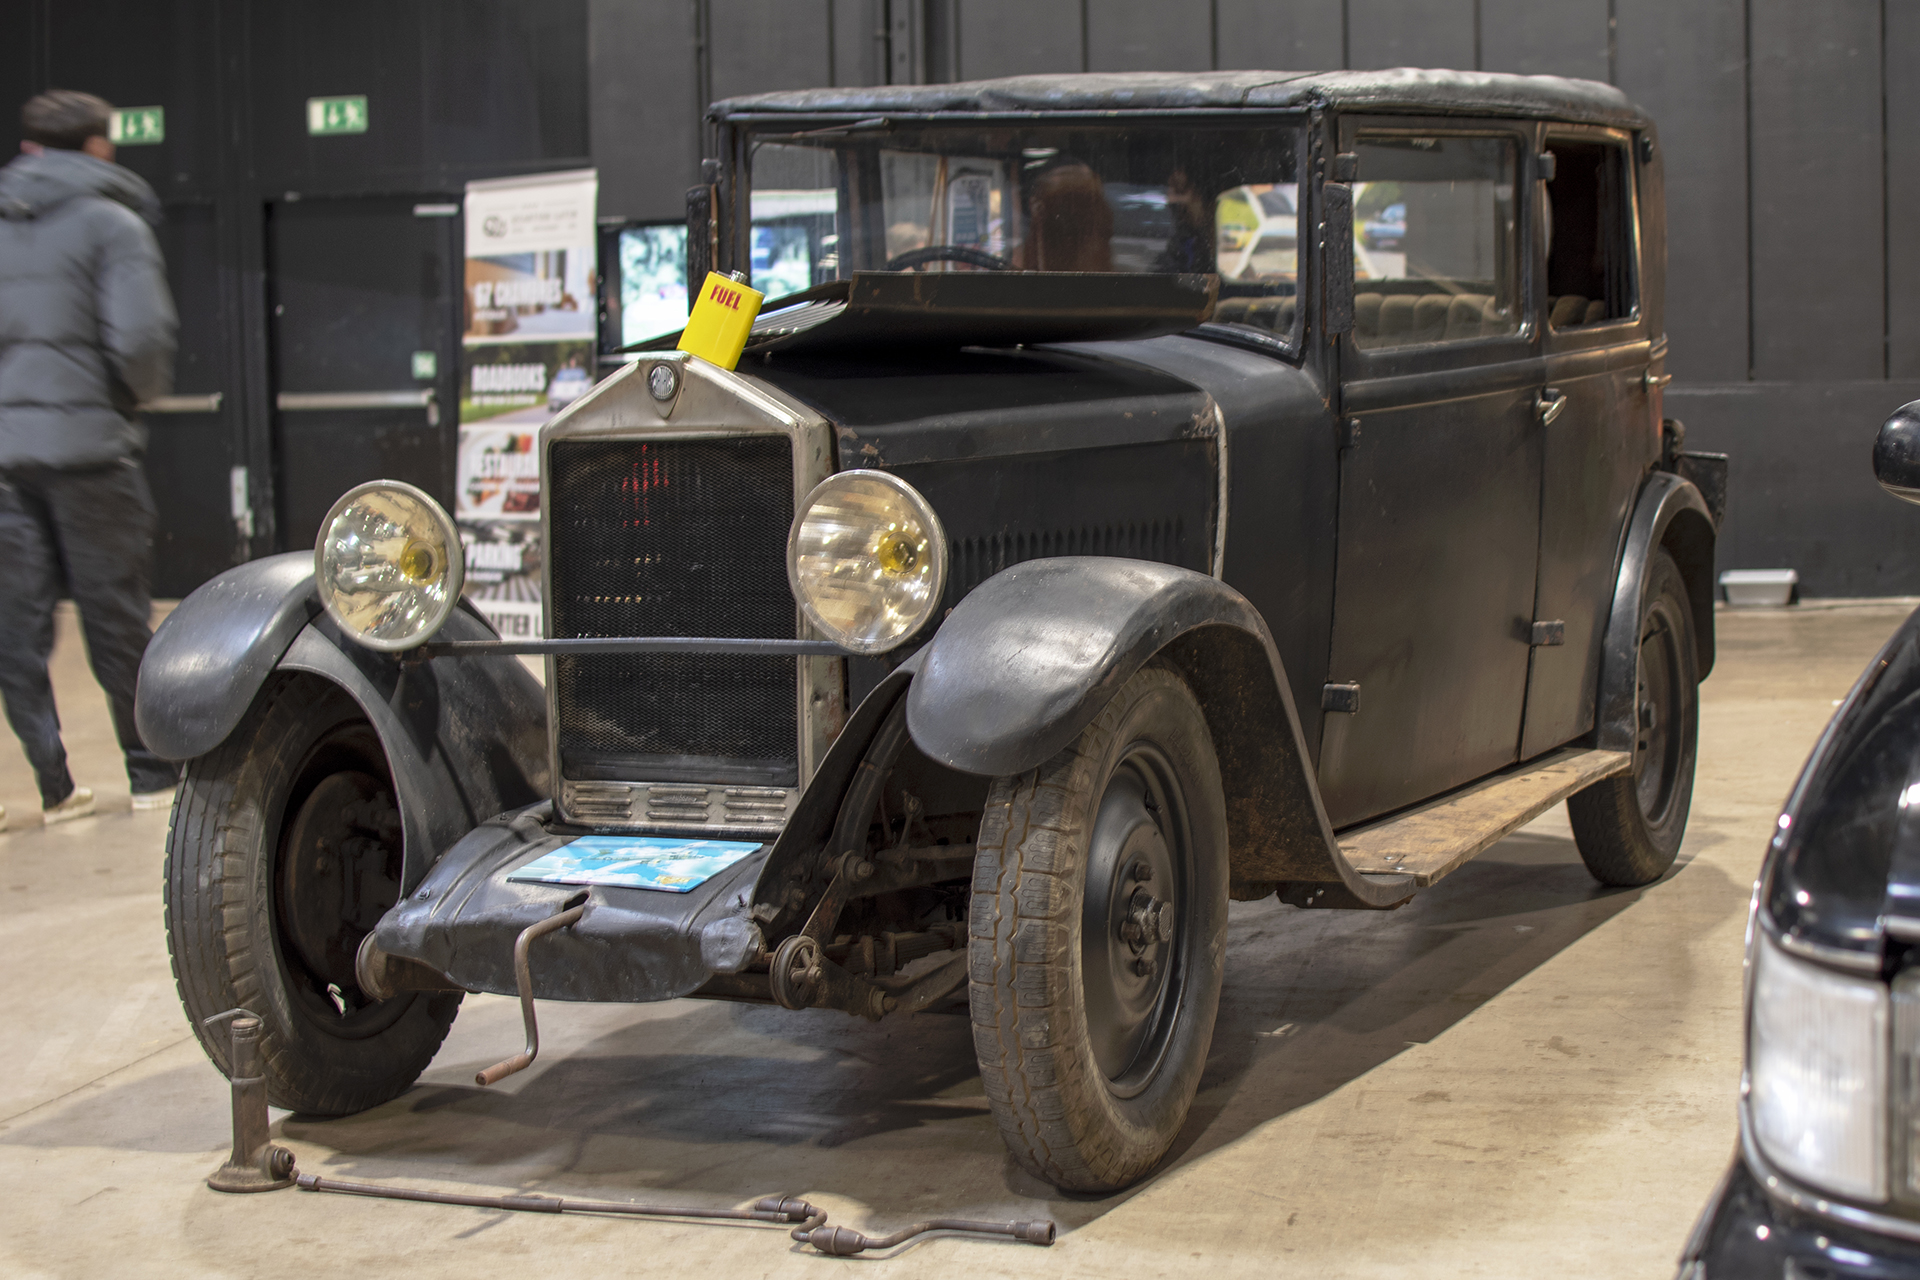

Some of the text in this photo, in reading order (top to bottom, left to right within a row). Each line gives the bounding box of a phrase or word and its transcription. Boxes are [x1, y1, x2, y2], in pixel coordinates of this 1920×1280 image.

[709, 283, 742, 311] FUEL
[472, 363, 547, 392] ROADBOOKS
[464, 542, 523, 571] PARKING
